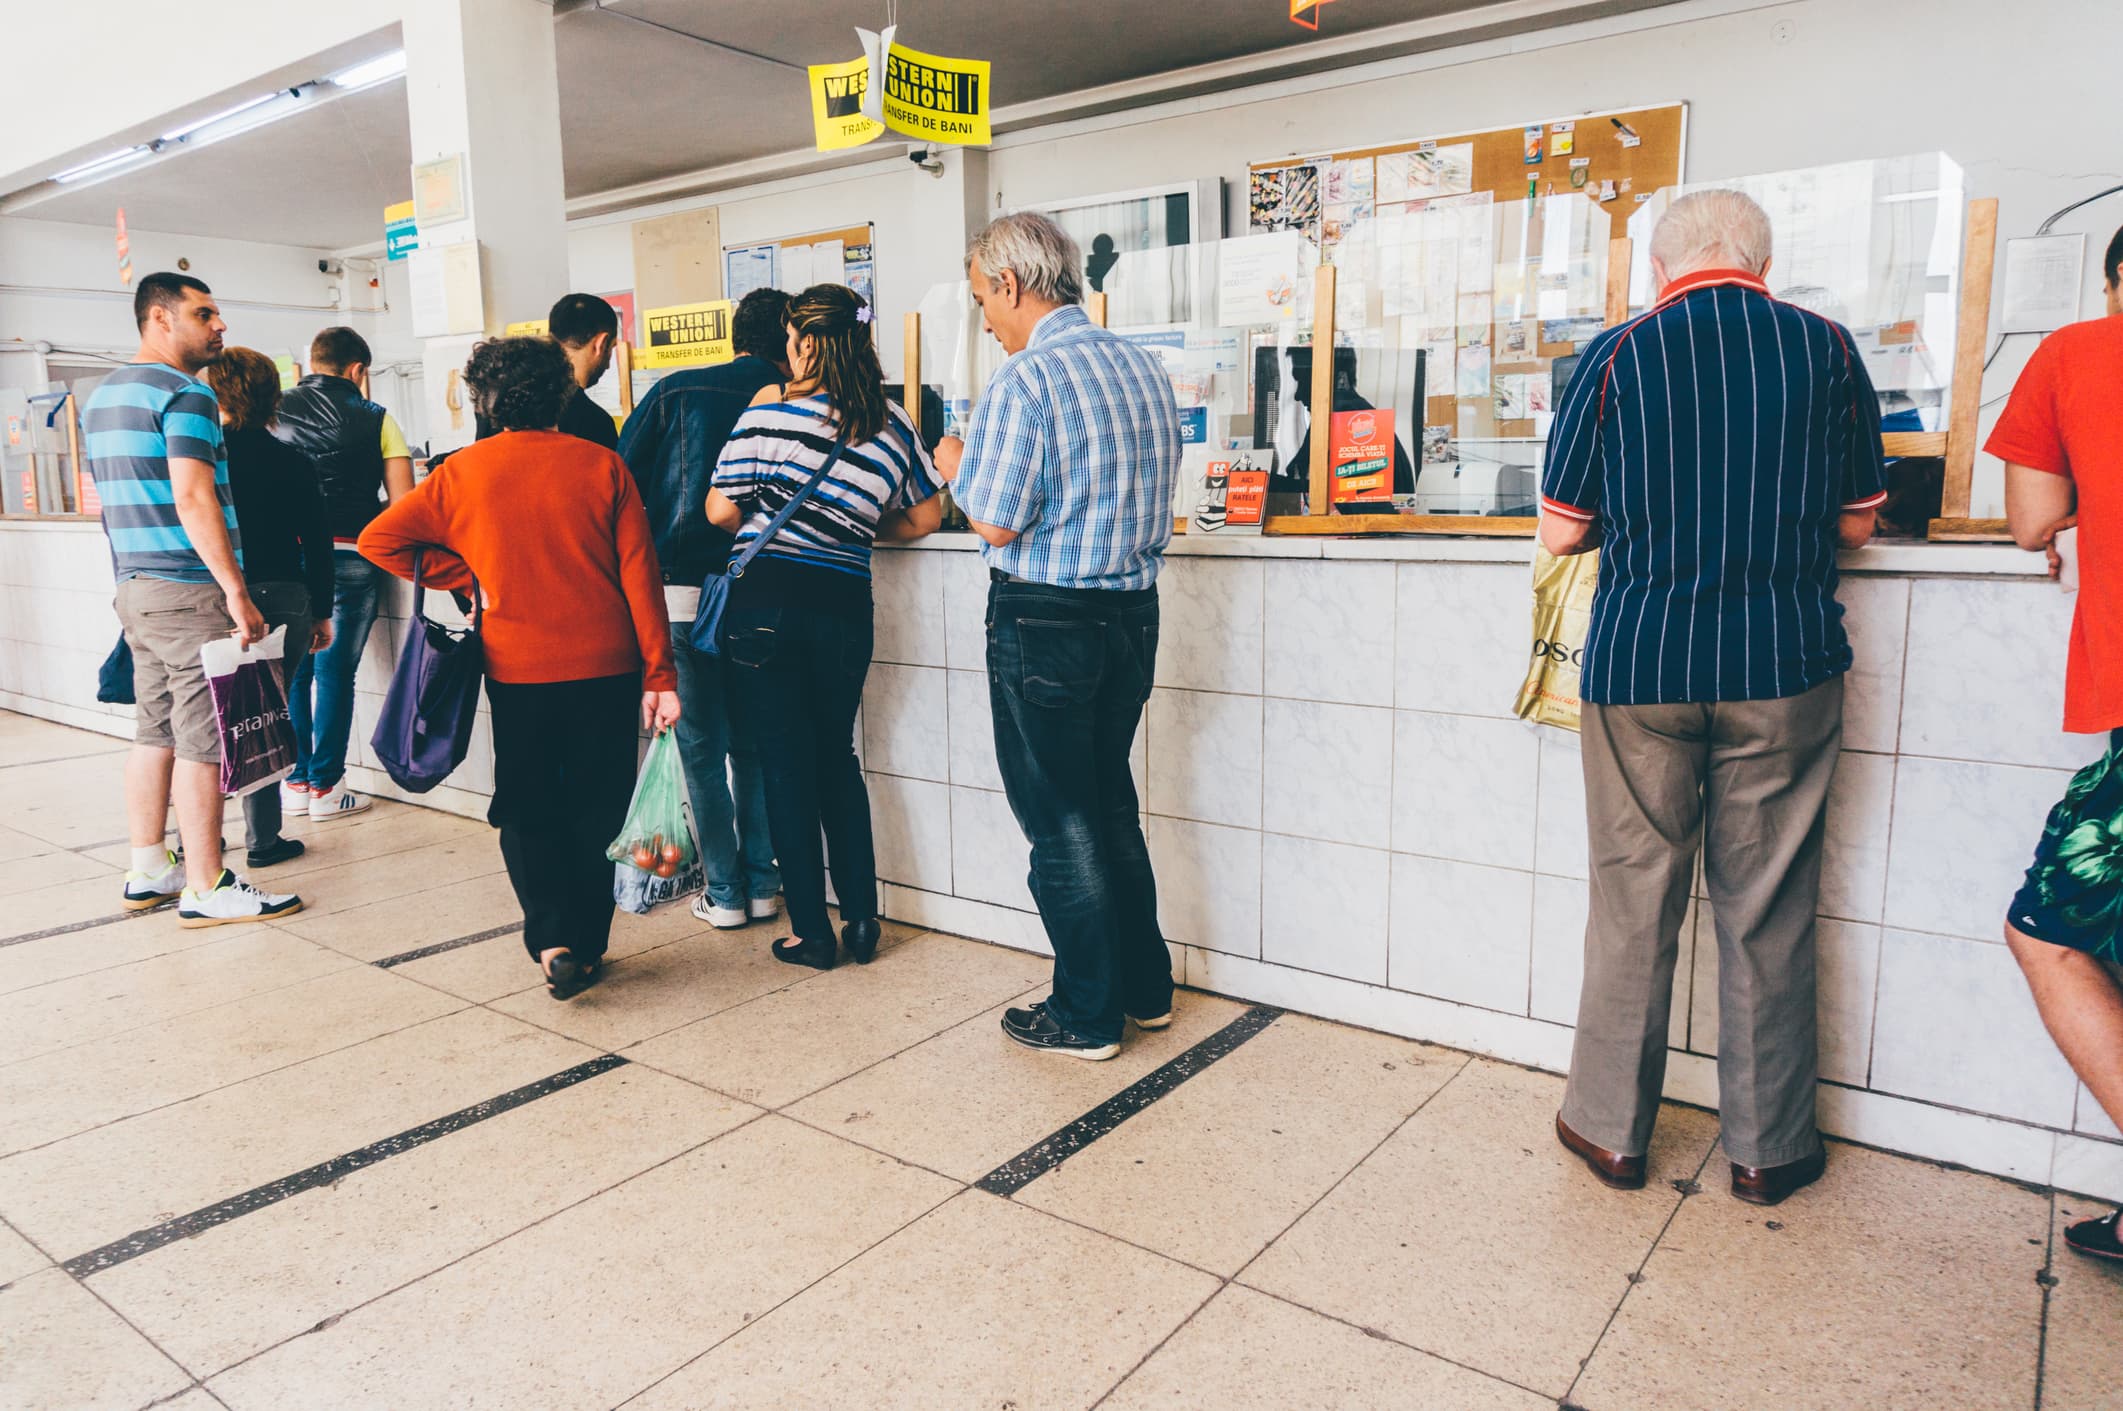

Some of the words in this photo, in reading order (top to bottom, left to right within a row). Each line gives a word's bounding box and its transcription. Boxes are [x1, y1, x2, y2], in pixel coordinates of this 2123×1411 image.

[886, 55, 953, 92] STERN
[888, 76, 953, 112] UNION
[922, 116, 937, 130] DE
[940, 120, 973, 134] BANI
[650, 311, 714, 332] WESTERN
[669, 325, 714, 344] UNION
[656, 349, 693, 361] TRANSFER
[693, 347, 704, 357] DE
[705, 345, 724, 356] BANI
[1181, 423, 1195, 438] BS
[1232, 493, 1257, 502] RATELE
